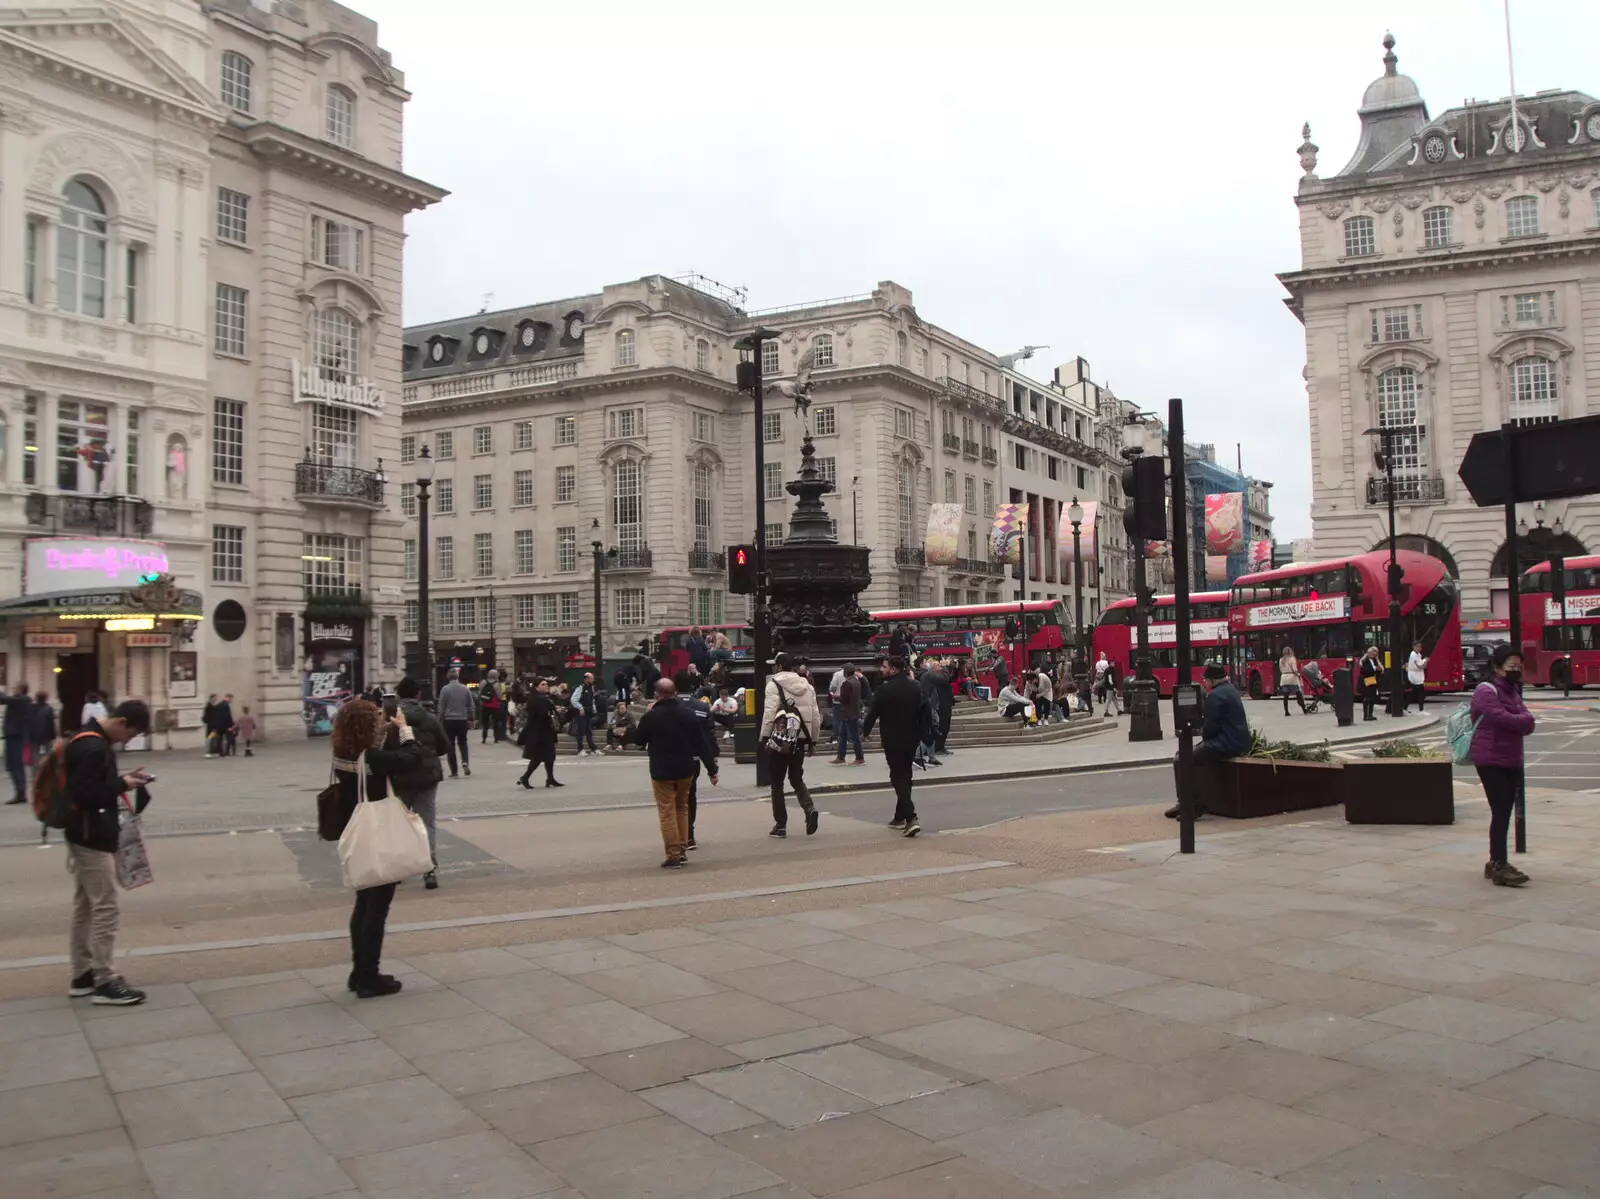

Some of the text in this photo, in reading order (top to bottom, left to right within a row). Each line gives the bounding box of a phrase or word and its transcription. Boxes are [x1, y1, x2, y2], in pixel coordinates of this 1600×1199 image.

[1257, 608, 1268, 618] THE
[1268, 604, 1297, 617] MORMONS
[1300, 602, 1313, 613] ARE
[1315, 600, 1336, 612] BACK!
[1424, 603, 1437, 615] 38
